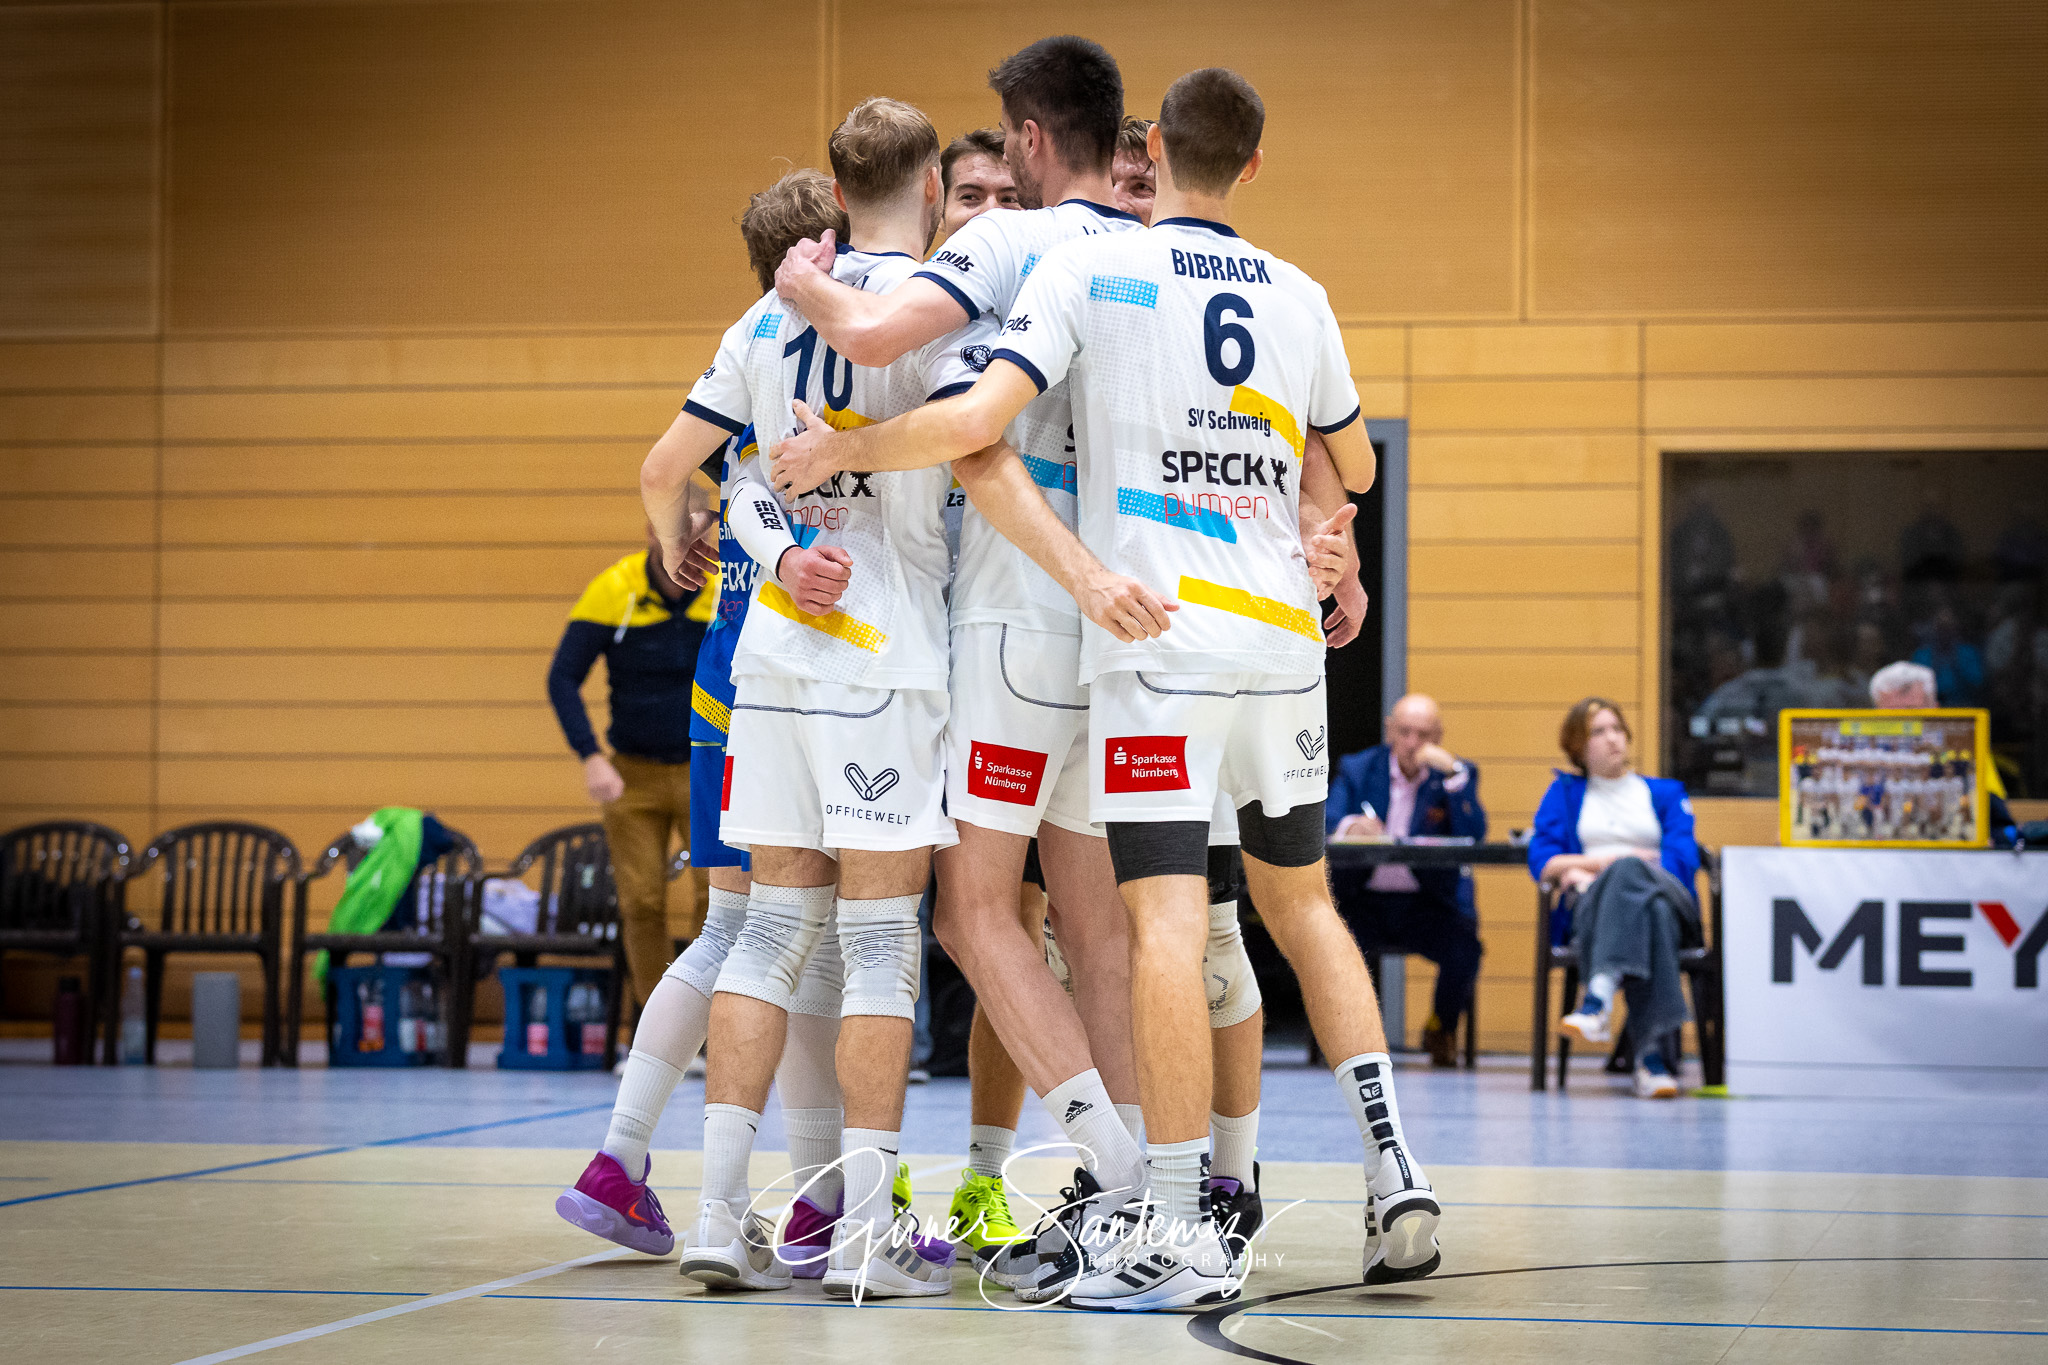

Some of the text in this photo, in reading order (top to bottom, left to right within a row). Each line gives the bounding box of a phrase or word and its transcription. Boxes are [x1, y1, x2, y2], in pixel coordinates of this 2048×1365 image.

[1171, 248, 1272, 285] BIBRACK
[1203, 292, 1256, 387] 6
[783, 325, 853, 412] 10
[1188, 407, 1272, 437] SV Schwaig
[1161, 450, 1268, 486] SPECK
[1164, 492, 1269, 525] pumpen
[721, 561, 750, 592] ECK
[986, 761, 1033, 779] Sparkasse
[1131, 753, 1177, 766] Sparkasse
[1131, 767, 1179, 779] Nürnberg
[826, 804, 911, 825] OFFICEWELT
[1770, 897, 2048, 989] MEY
[1065, 1103, 1094, 1124] adidas
